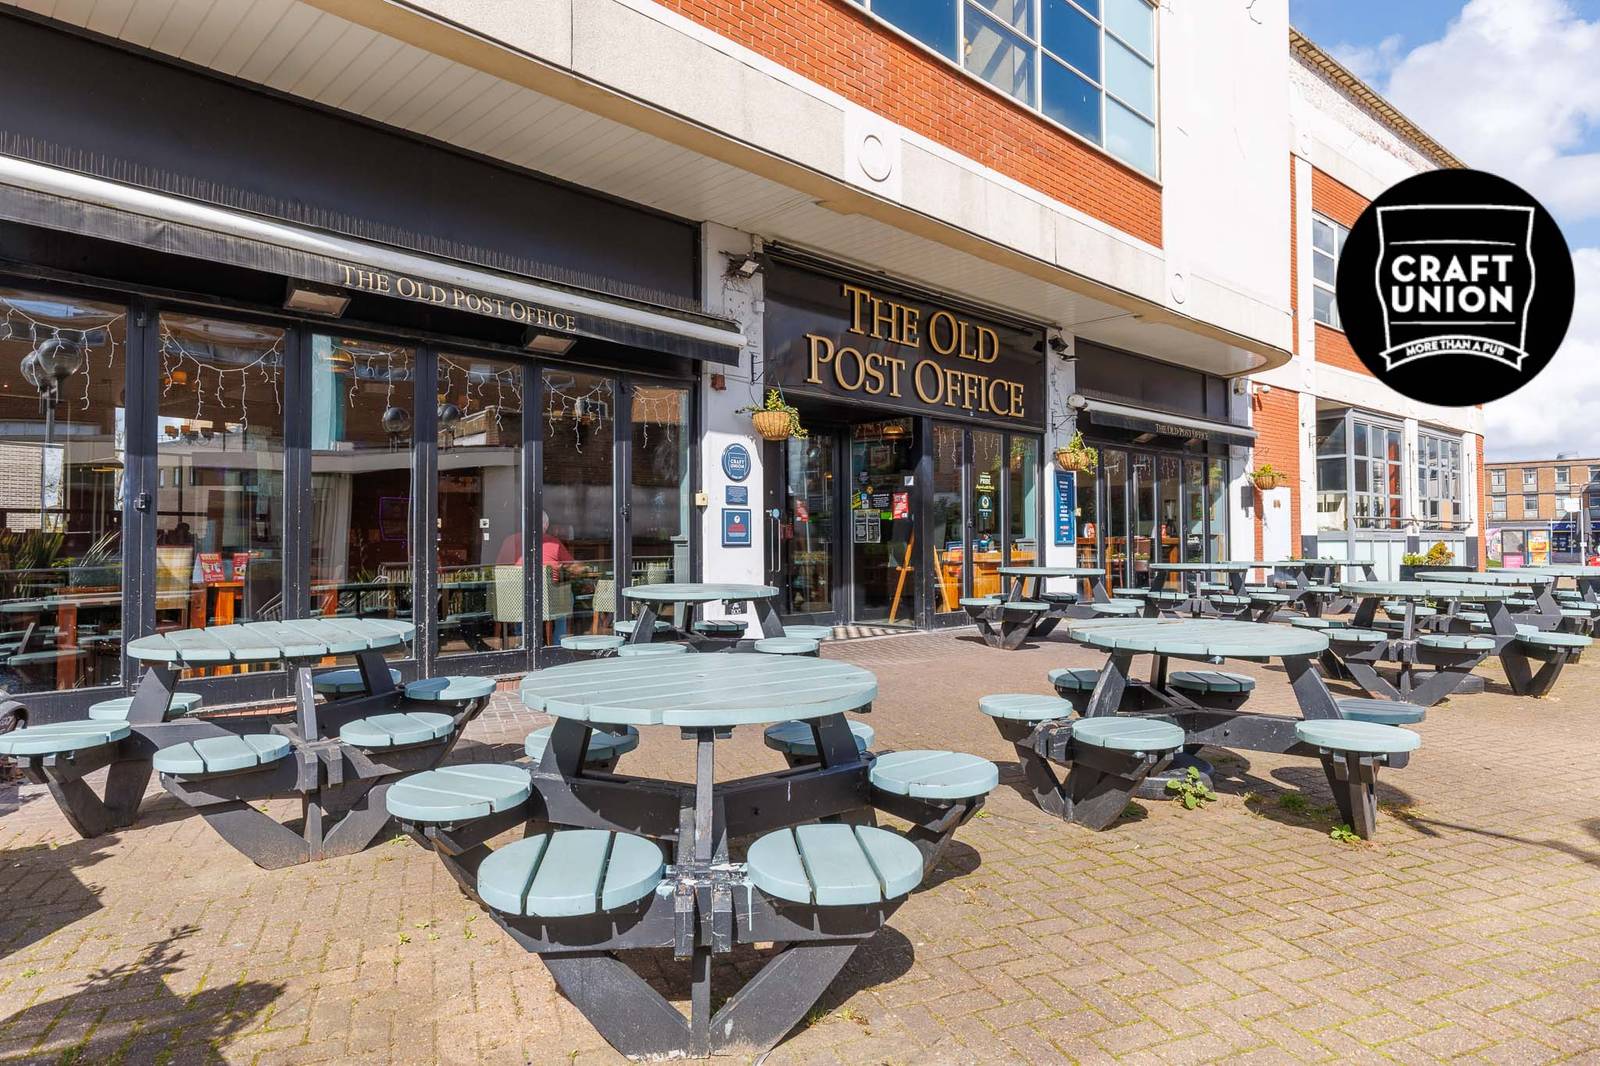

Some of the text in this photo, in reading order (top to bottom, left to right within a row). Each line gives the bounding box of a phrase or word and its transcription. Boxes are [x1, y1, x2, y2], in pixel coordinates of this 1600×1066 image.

[338, 264, 577, 332] THE OLD POST OFFICE
[844, 284, 999, 364] THE OLD
[806, 334, 1025, 418] POST OFFICE
